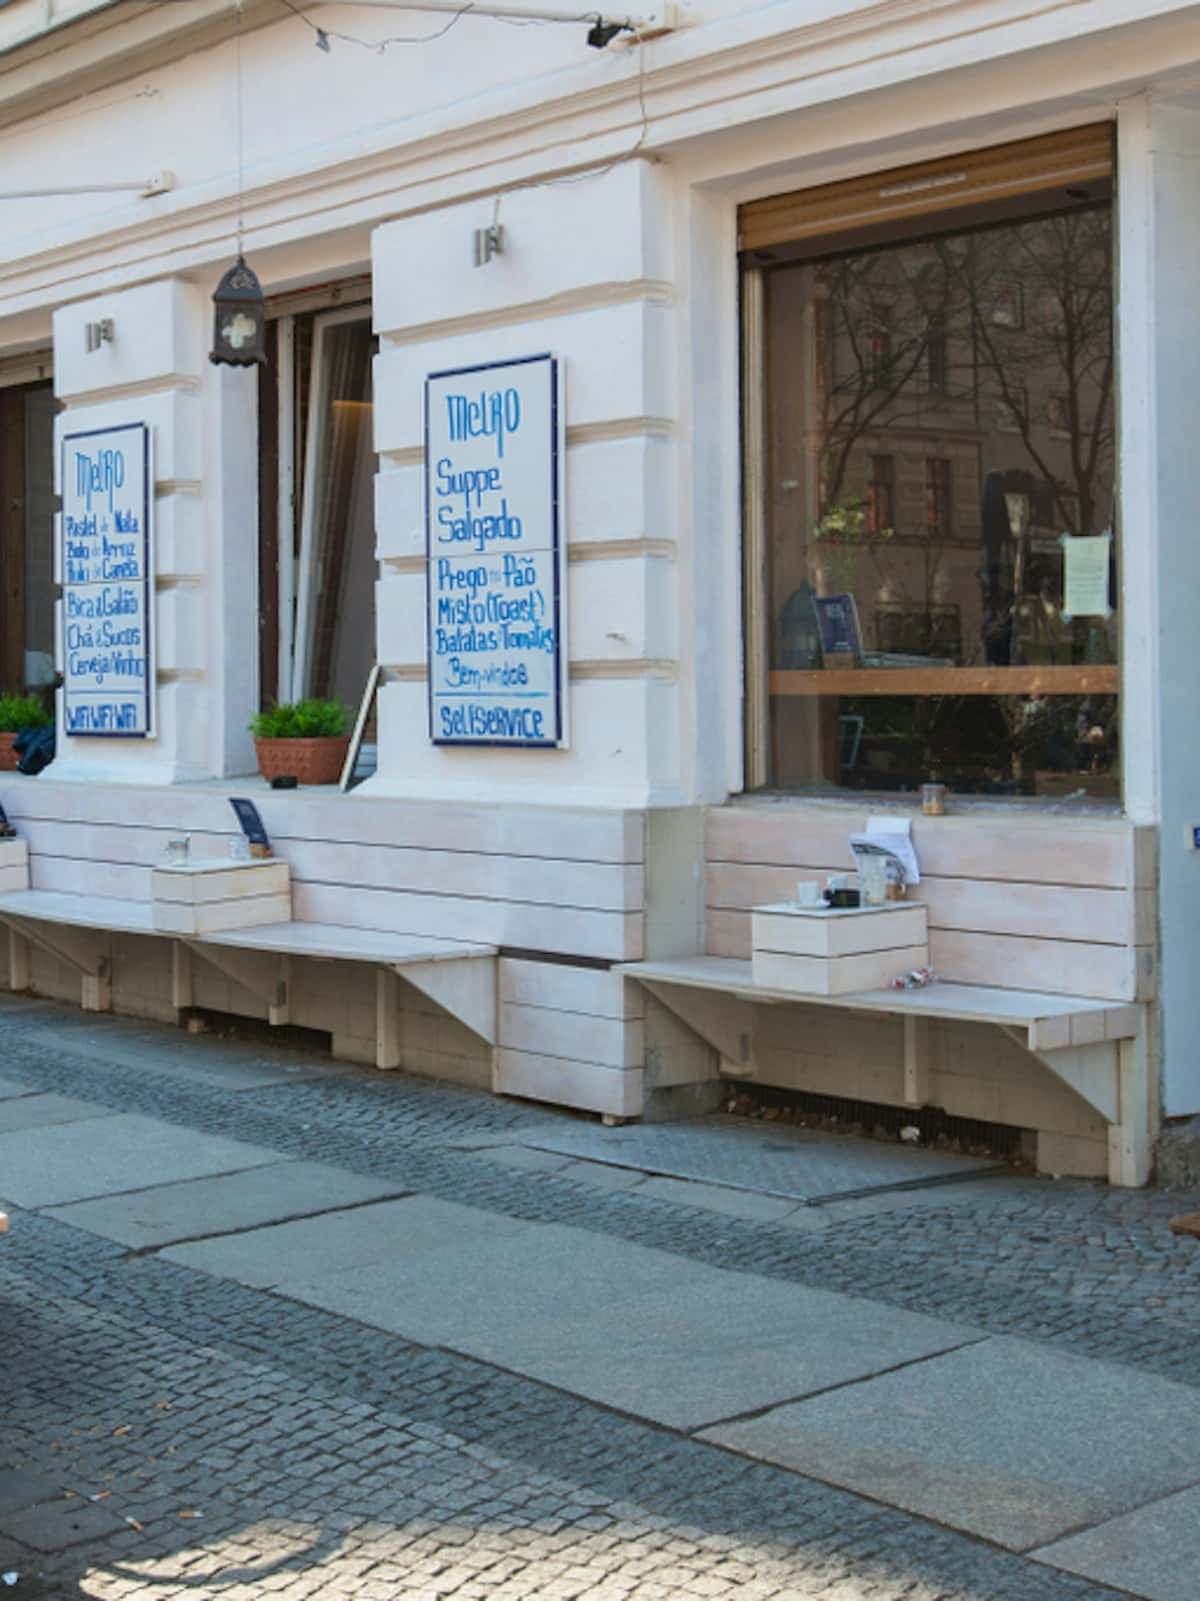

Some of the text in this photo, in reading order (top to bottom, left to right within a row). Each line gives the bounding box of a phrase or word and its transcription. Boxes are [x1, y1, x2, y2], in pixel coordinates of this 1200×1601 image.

[436, 458, 502, 508] Suppe
[438, 498, 523, 551] Salgado
[438, 557, 488, 600] Prego
